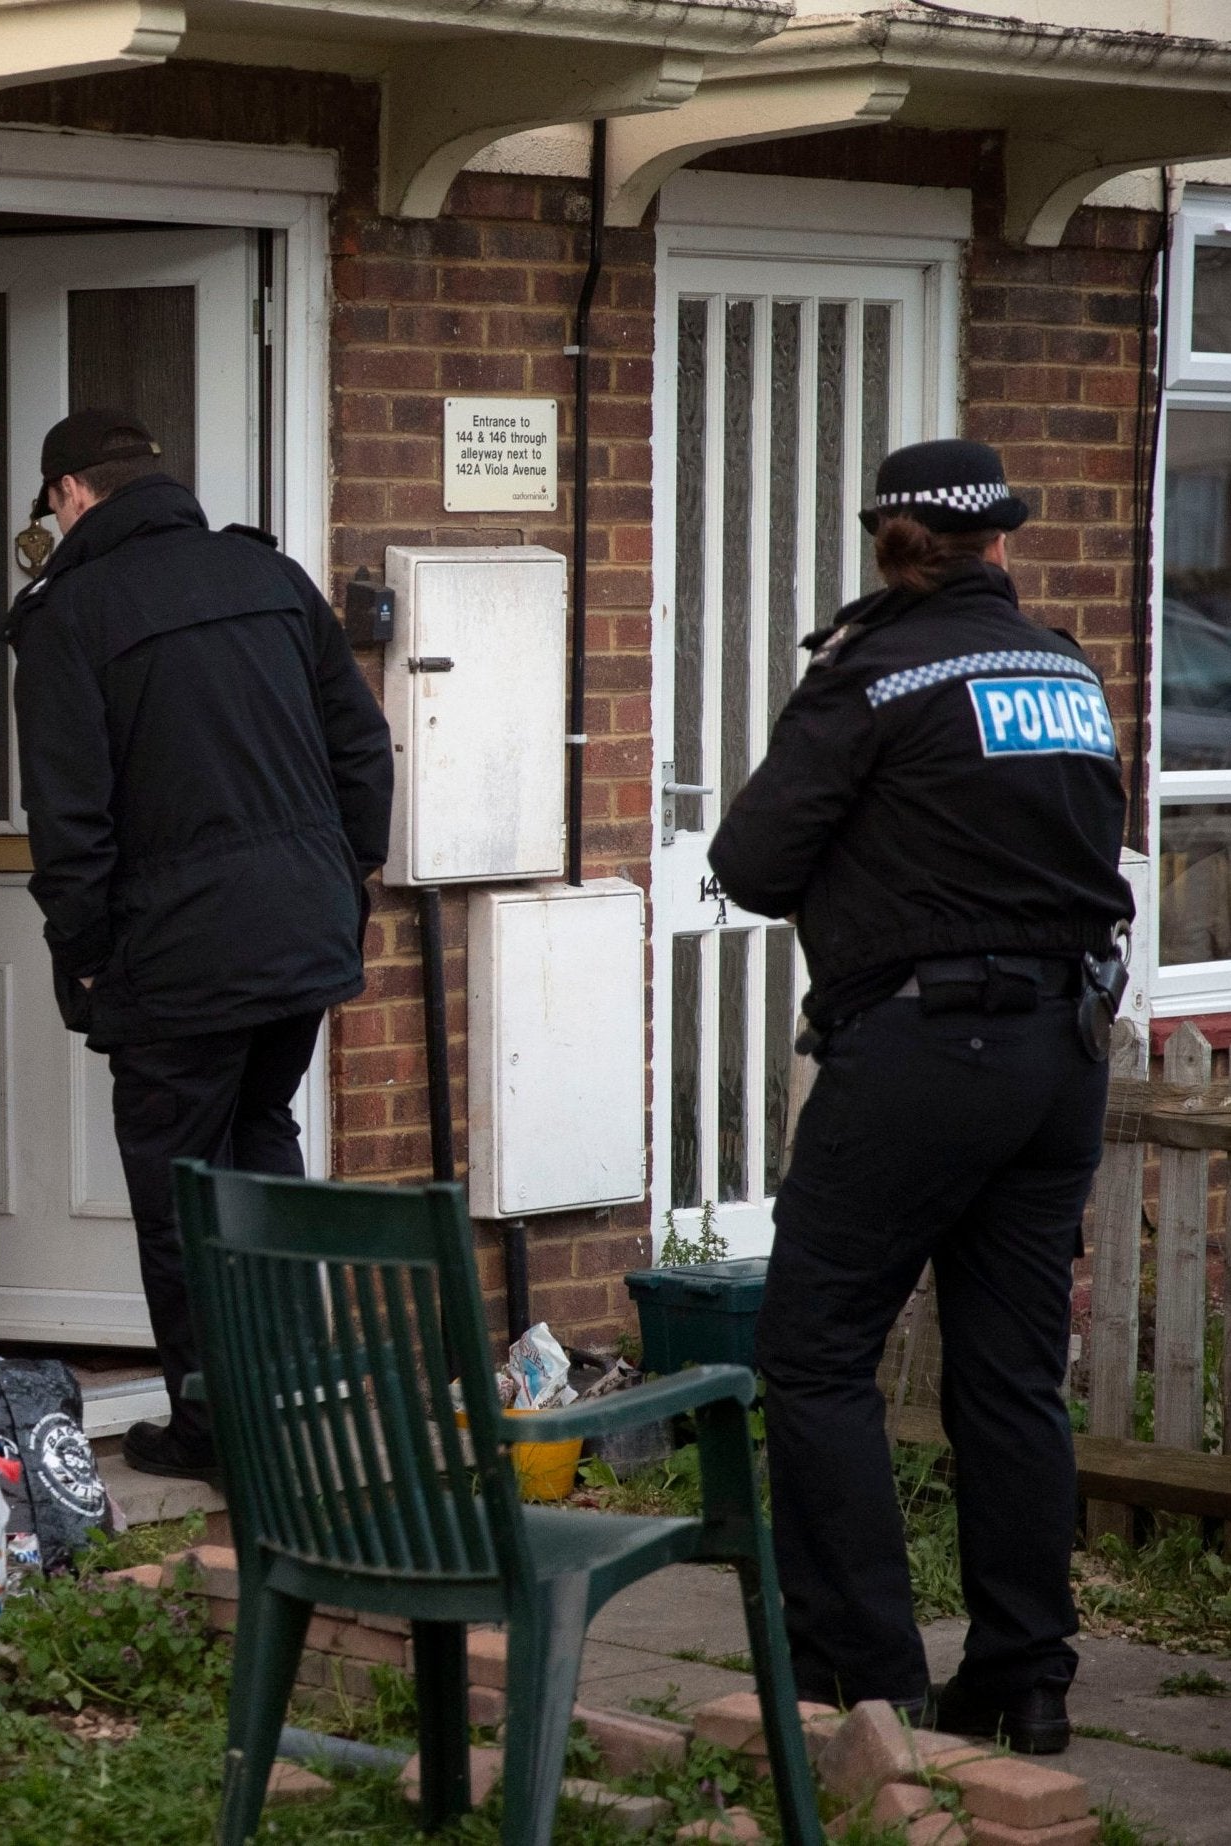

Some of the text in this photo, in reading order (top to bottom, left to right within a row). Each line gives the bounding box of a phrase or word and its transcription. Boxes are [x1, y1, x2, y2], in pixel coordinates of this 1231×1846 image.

[473, 415, 530, 428] Entrance to
[456, 430, 547, 446] 144 & 146 through
[461, 447, 542, 462] alleyway next to
[456, 463, 547, 476] 142A Viola Avenue
[986, 689, 1111, 746] POLICE
[699, 873, 724, 902] 14
